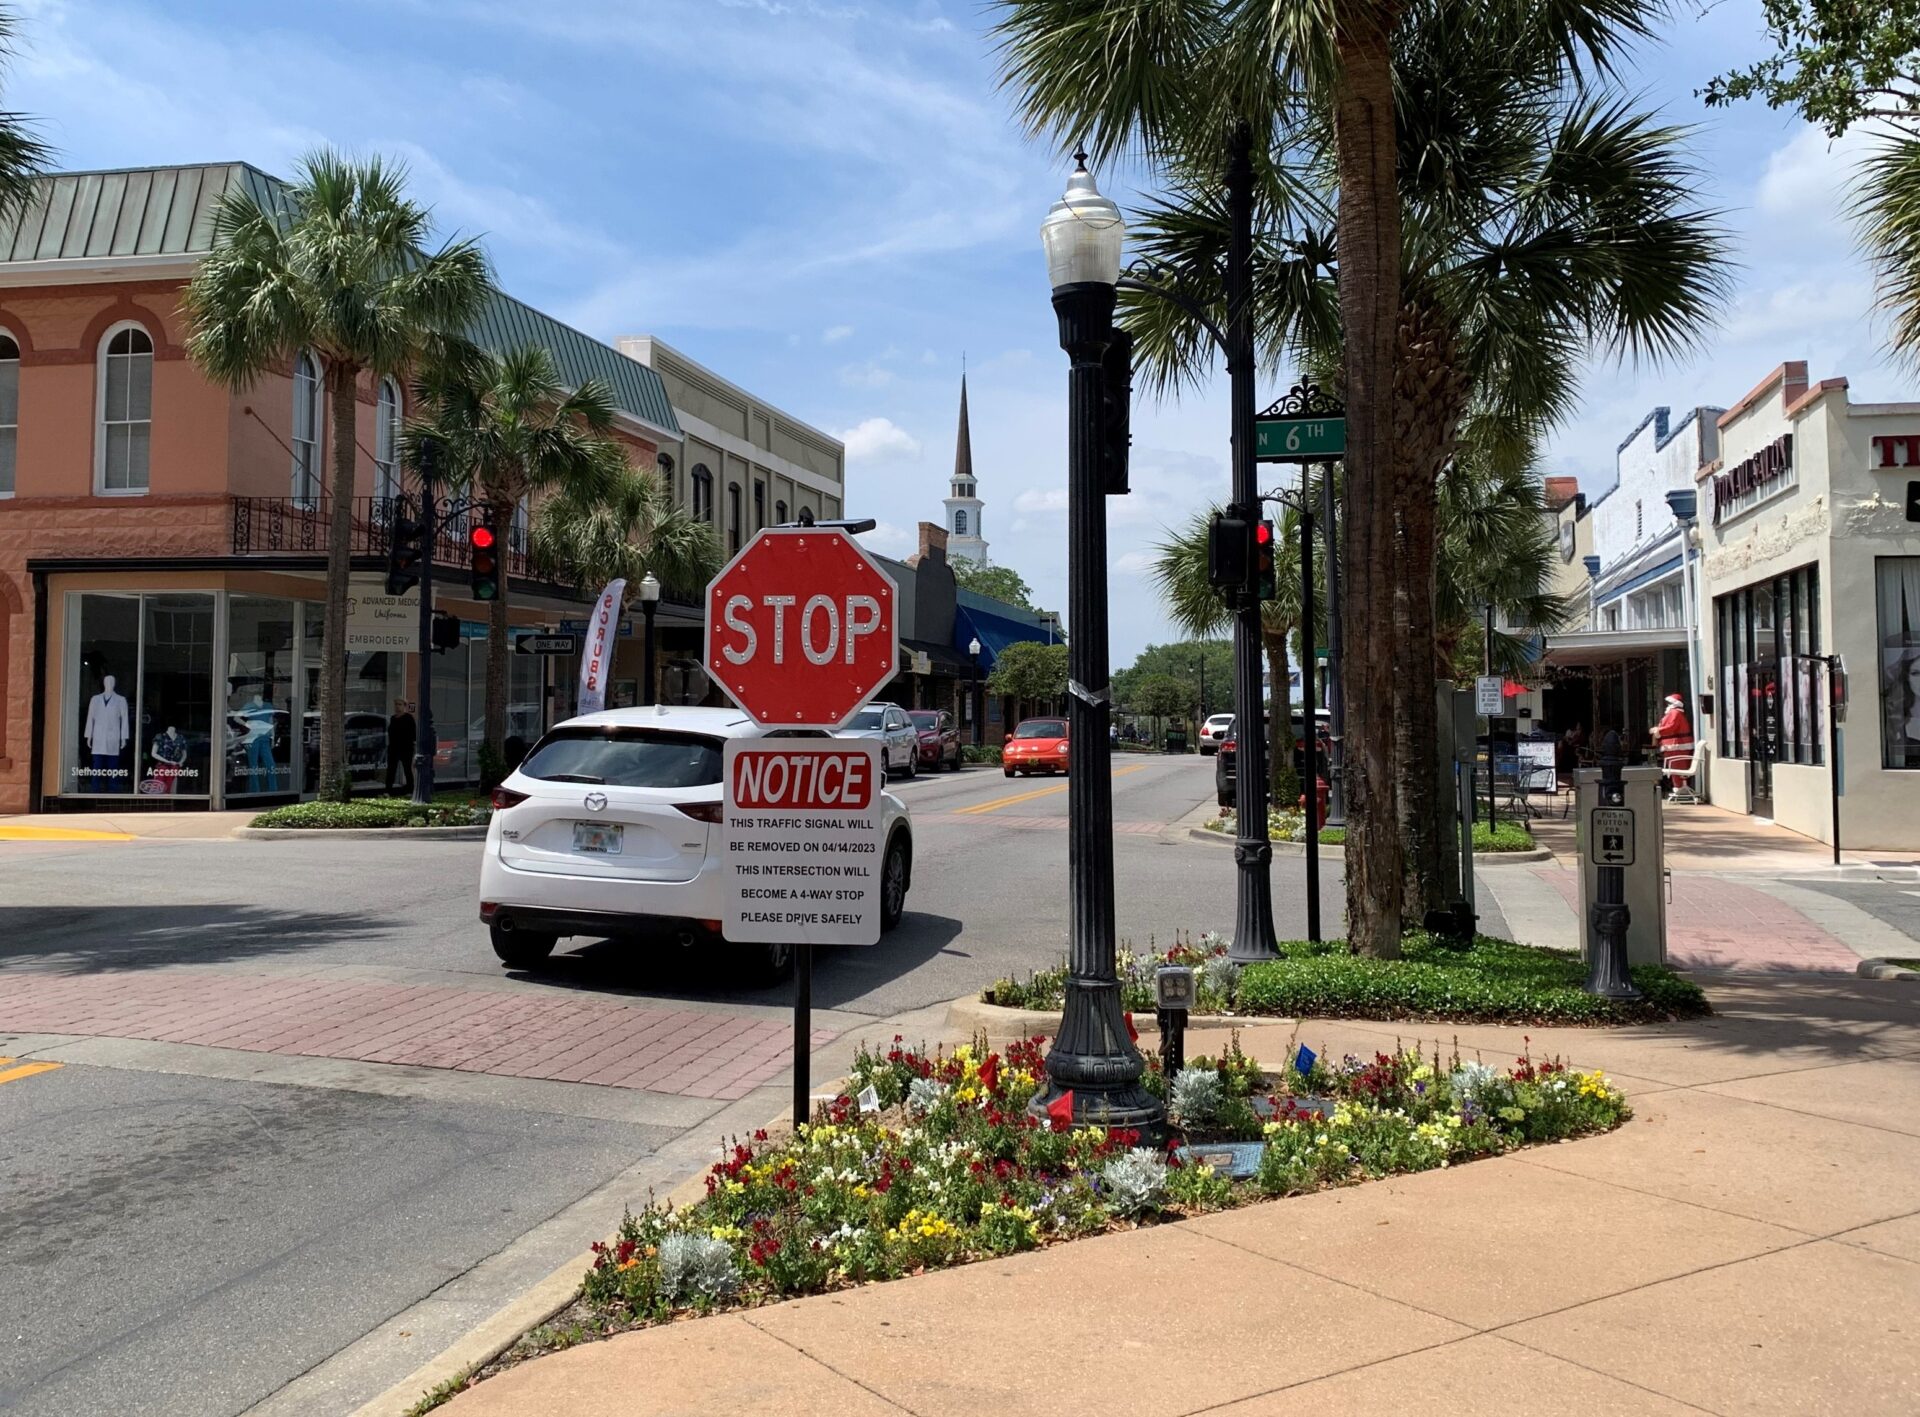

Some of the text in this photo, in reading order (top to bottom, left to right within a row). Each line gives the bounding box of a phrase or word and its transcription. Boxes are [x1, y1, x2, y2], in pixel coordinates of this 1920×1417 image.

[1258, 432, 1268, 446] N
[1752, 433, 1793, 487] SALON
[362, 596, 421, 607] ADVANCED MEDIC
[374, 608, 408, 621] Uniforms
[722, 594, 882, 665] STOP
[349, 634, 410, 645] EMBROIDERY
[536, 640, 570, 649] ONE WAY
[71, 766, 128, 778] Stethoscopes
[147, 767, 199, 777] Accessories
[234, 765, 292, 777] Embroidery Scrubs
[737, 755, 866, 804] NOTICE
[730, 818, 874, 829] THIS TRAFFIC SIGNAL WILL
[730, 842, 876, 853] BE REMOVED ON 04/14/2023
[736, 865, 870, 876] THIS INTERSECTION WILL
[741, 889, 865, 900] BECOME A 4-WAY STOP
[741, 912, 862, 924] PLEASE DRIVE SAFELY
